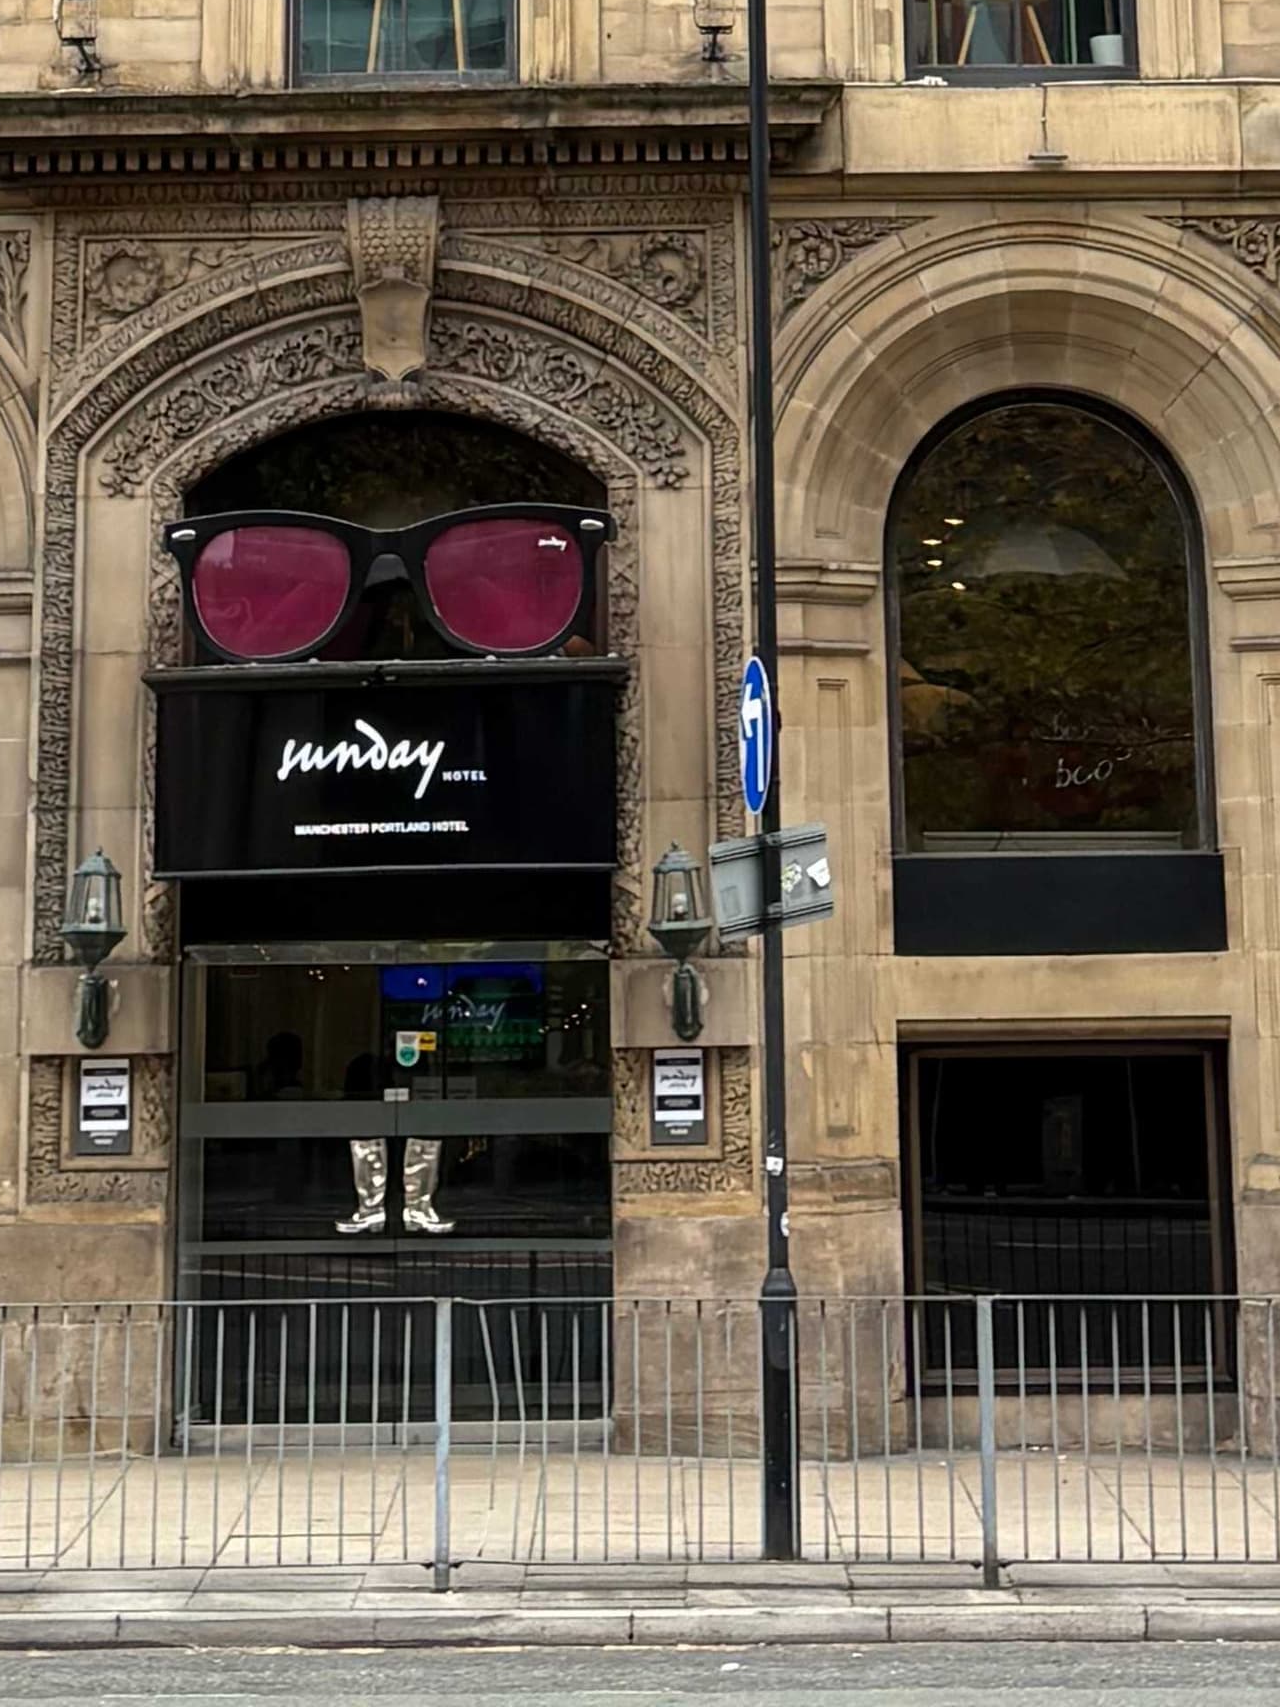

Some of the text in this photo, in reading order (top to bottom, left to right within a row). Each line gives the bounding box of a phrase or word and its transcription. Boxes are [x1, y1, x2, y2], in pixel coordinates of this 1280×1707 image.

[277, 718, 488, 800] sunday HOTEL
[294, 820, 469, 836] MANCHESTER PORTLAND HOTEL
